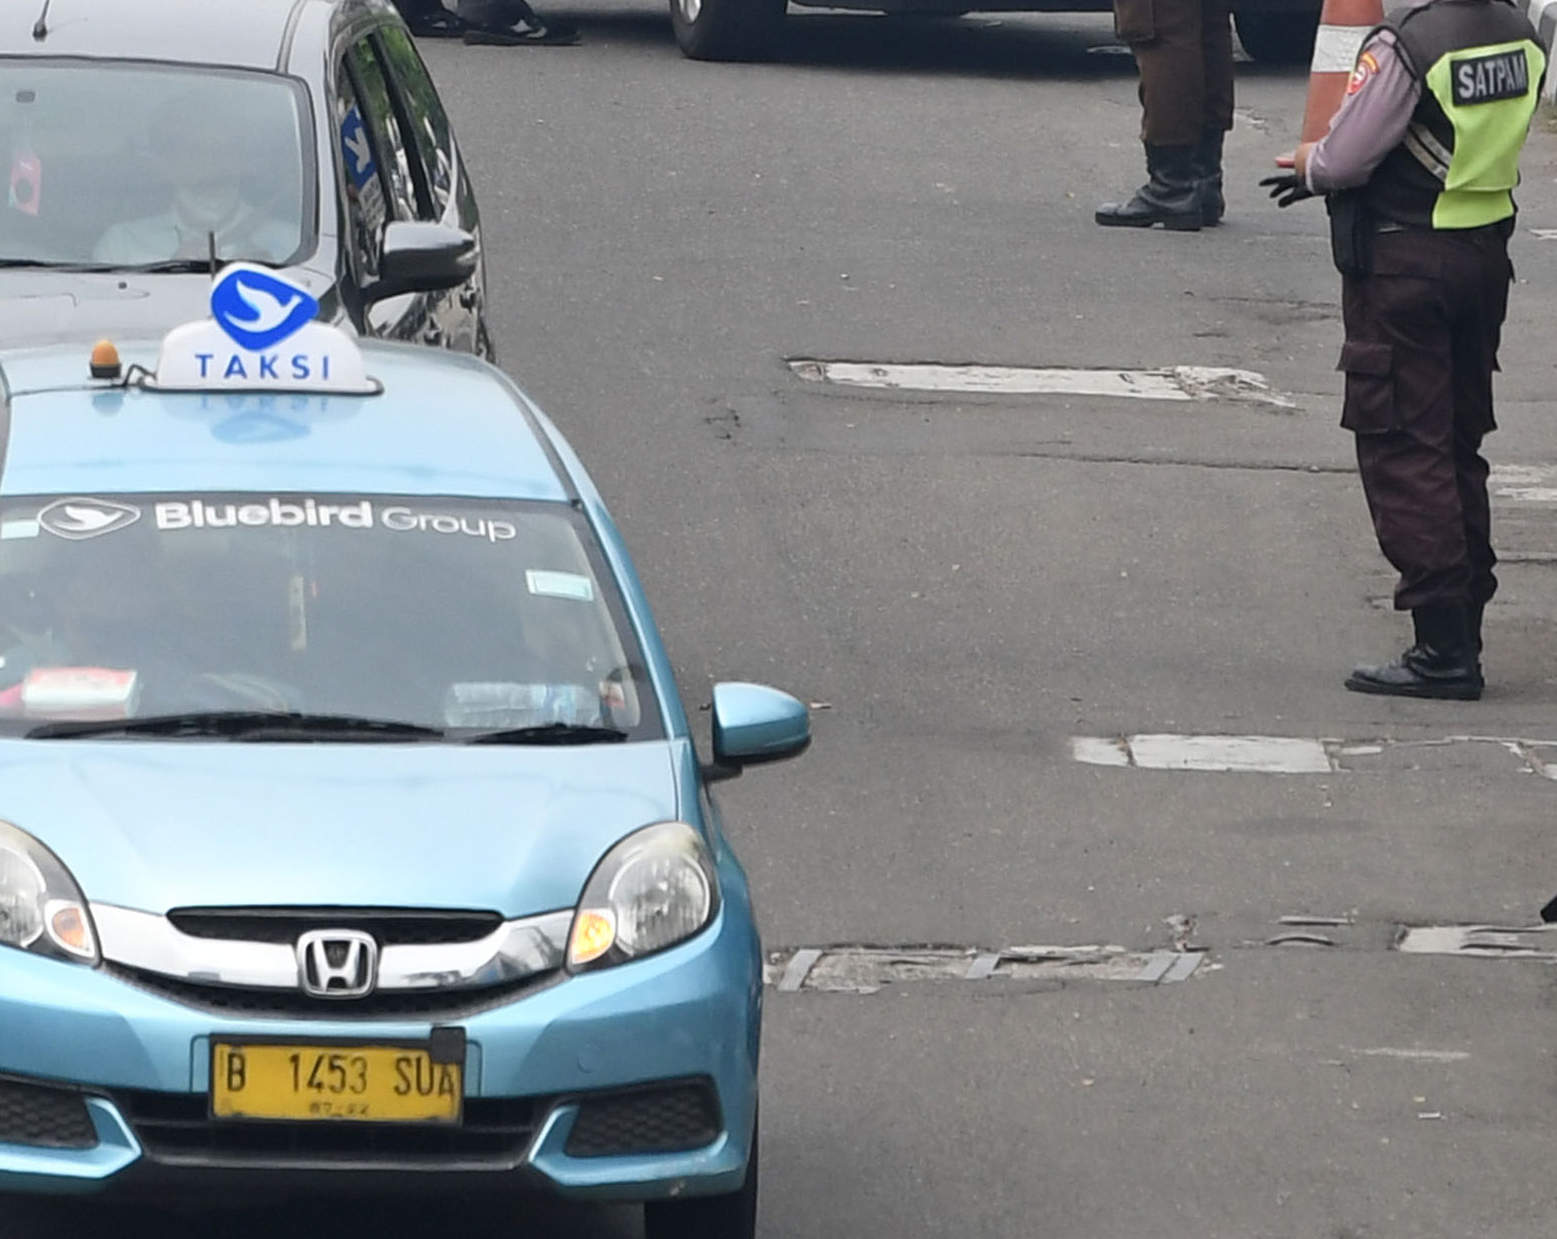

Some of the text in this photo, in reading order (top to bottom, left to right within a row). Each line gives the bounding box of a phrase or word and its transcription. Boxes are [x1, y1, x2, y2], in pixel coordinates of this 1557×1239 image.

[1458, 53, 1528, 99] SATPAM
[195, 354, 329, 380] TAKSI
[155, 499, 517, 542] Bluebird Group
[227, 1052, 455, 1098] B 1453 SUA
